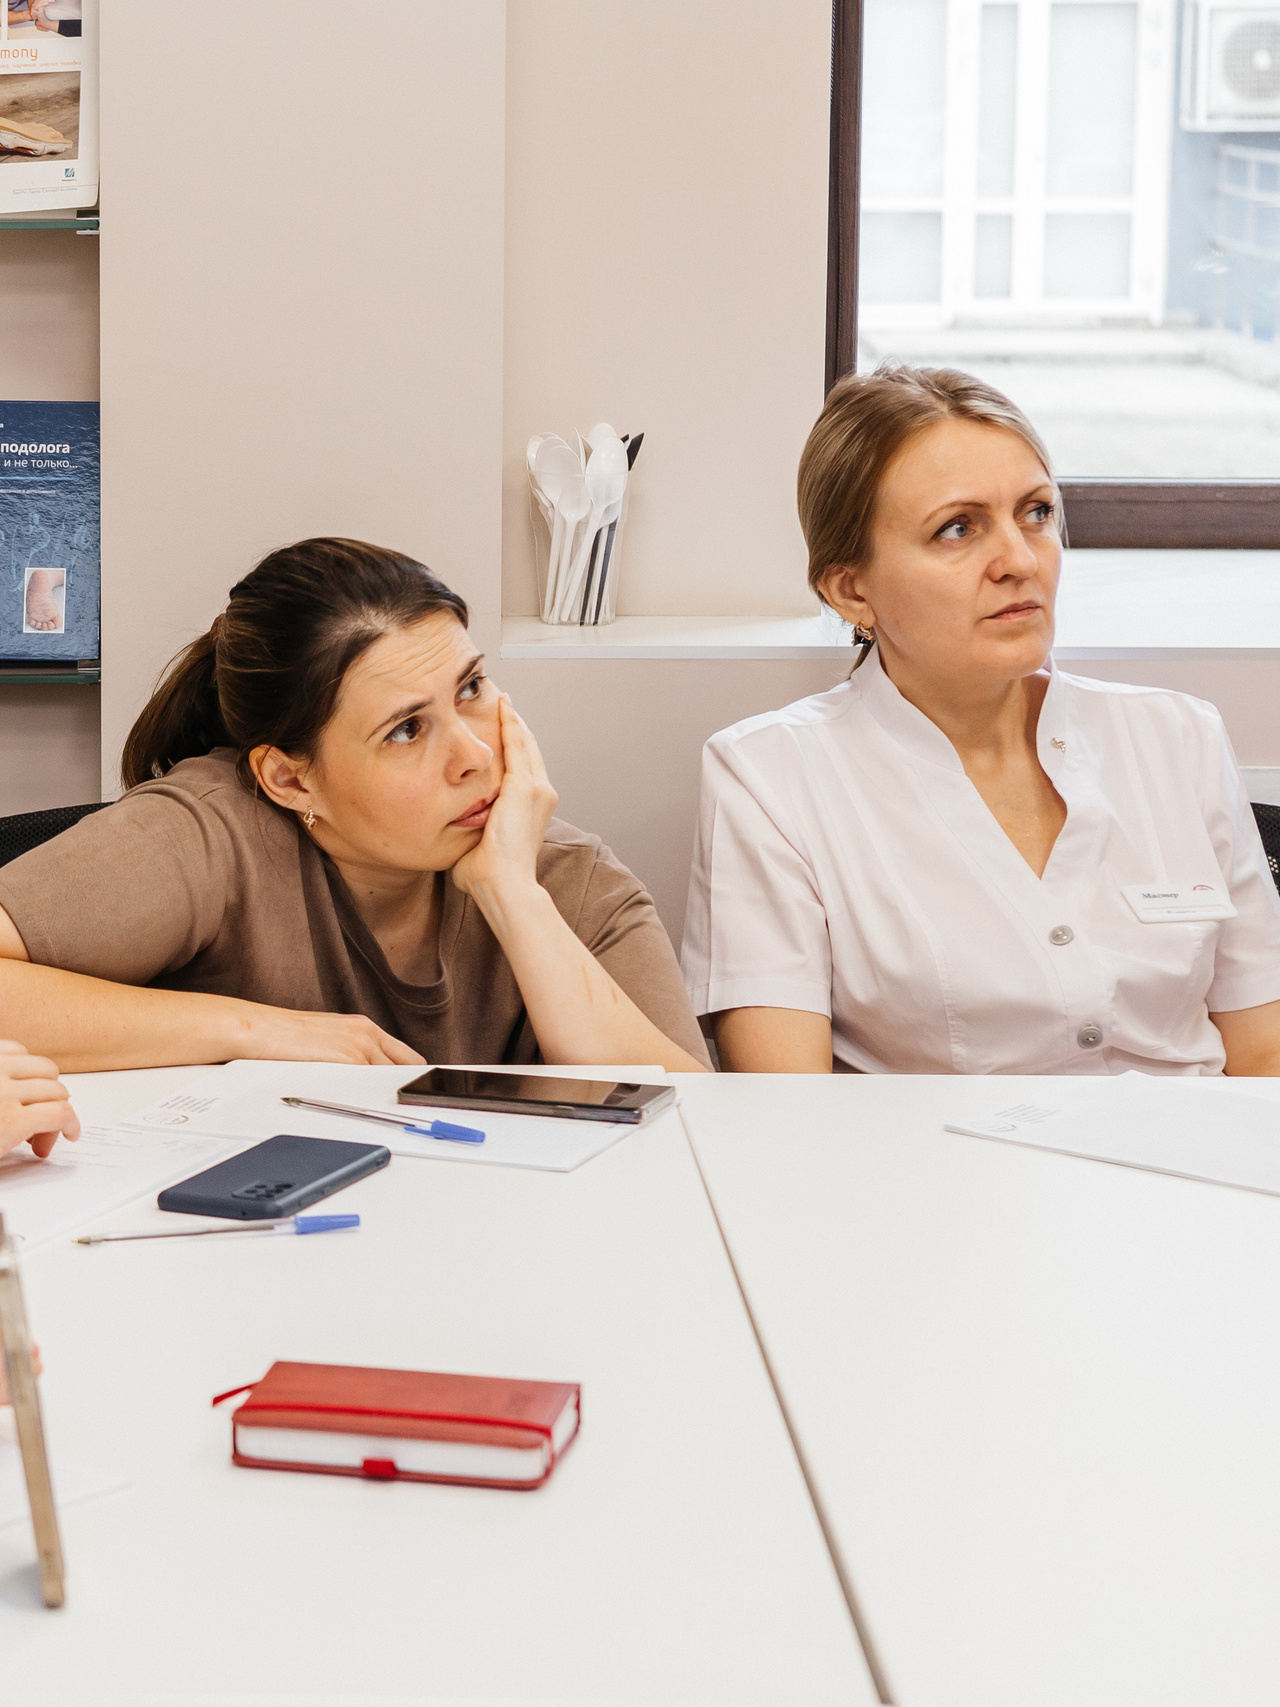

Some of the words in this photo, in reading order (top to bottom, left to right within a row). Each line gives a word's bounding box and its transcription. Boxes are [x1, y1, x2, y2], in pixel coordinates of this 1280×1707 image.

[0, 443, 70, 456] подолога
[4, 459, 11, 467] и
[14, 459, 28, 467] не
[31, 459, 78, 469] только...
